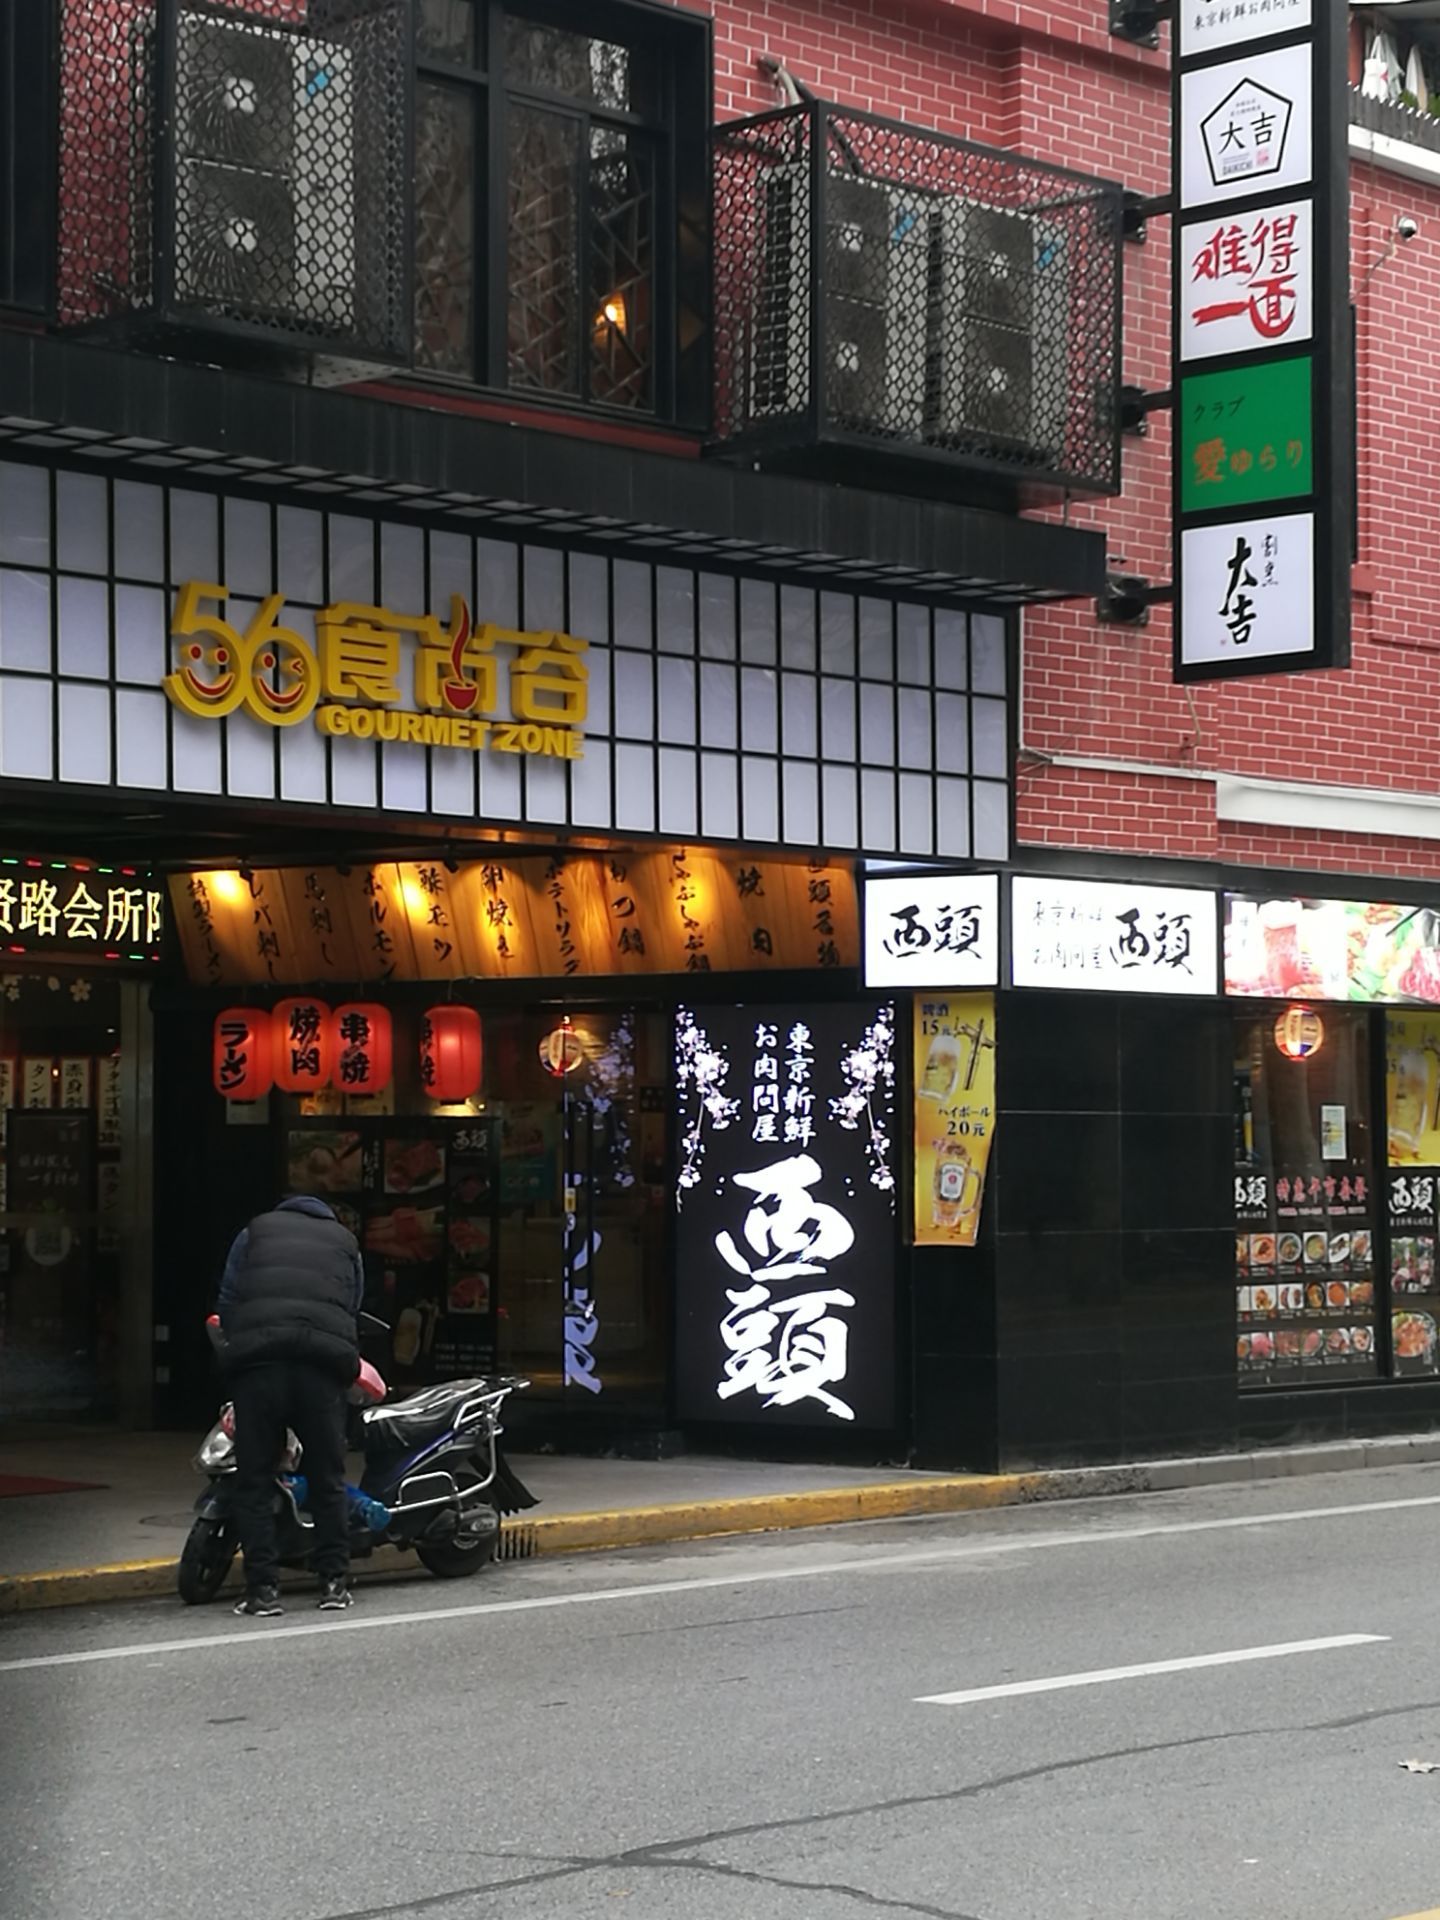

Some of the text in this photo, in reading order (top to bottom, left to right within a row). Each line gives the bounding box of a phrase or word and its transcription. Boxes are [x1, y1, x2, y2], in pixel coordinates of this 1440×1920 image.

[1219, 111, 1277, 154] 大吉
[1191, 214, 1300, 286] 难得
[1193, 395, 1247, 423] クラブ
[1192, 436, 1304, 486] 愛ゆらり
[1218, 536, 1258, 645] 大吉
[316, 704, 586, 761] GOURMET ZONE
[248, 871, 281, 982] レバ刺し
[363, 870, 398, 983] ホルモン
[736, 866, 774, 957] 焼肉
[219, 1022, 251, 1091] ラーメン
[290, 1004, 322, 1077] 焼肉
[340, 1012, 371, 1085] 串焼
[752, 1022, 781, 1143] お肉問屋
[782, 1022, 817, 1148] 東京新鮮
[937, 1105, 992, 1118] ハイボール
[946, 1120, 985, 1137] 20元
